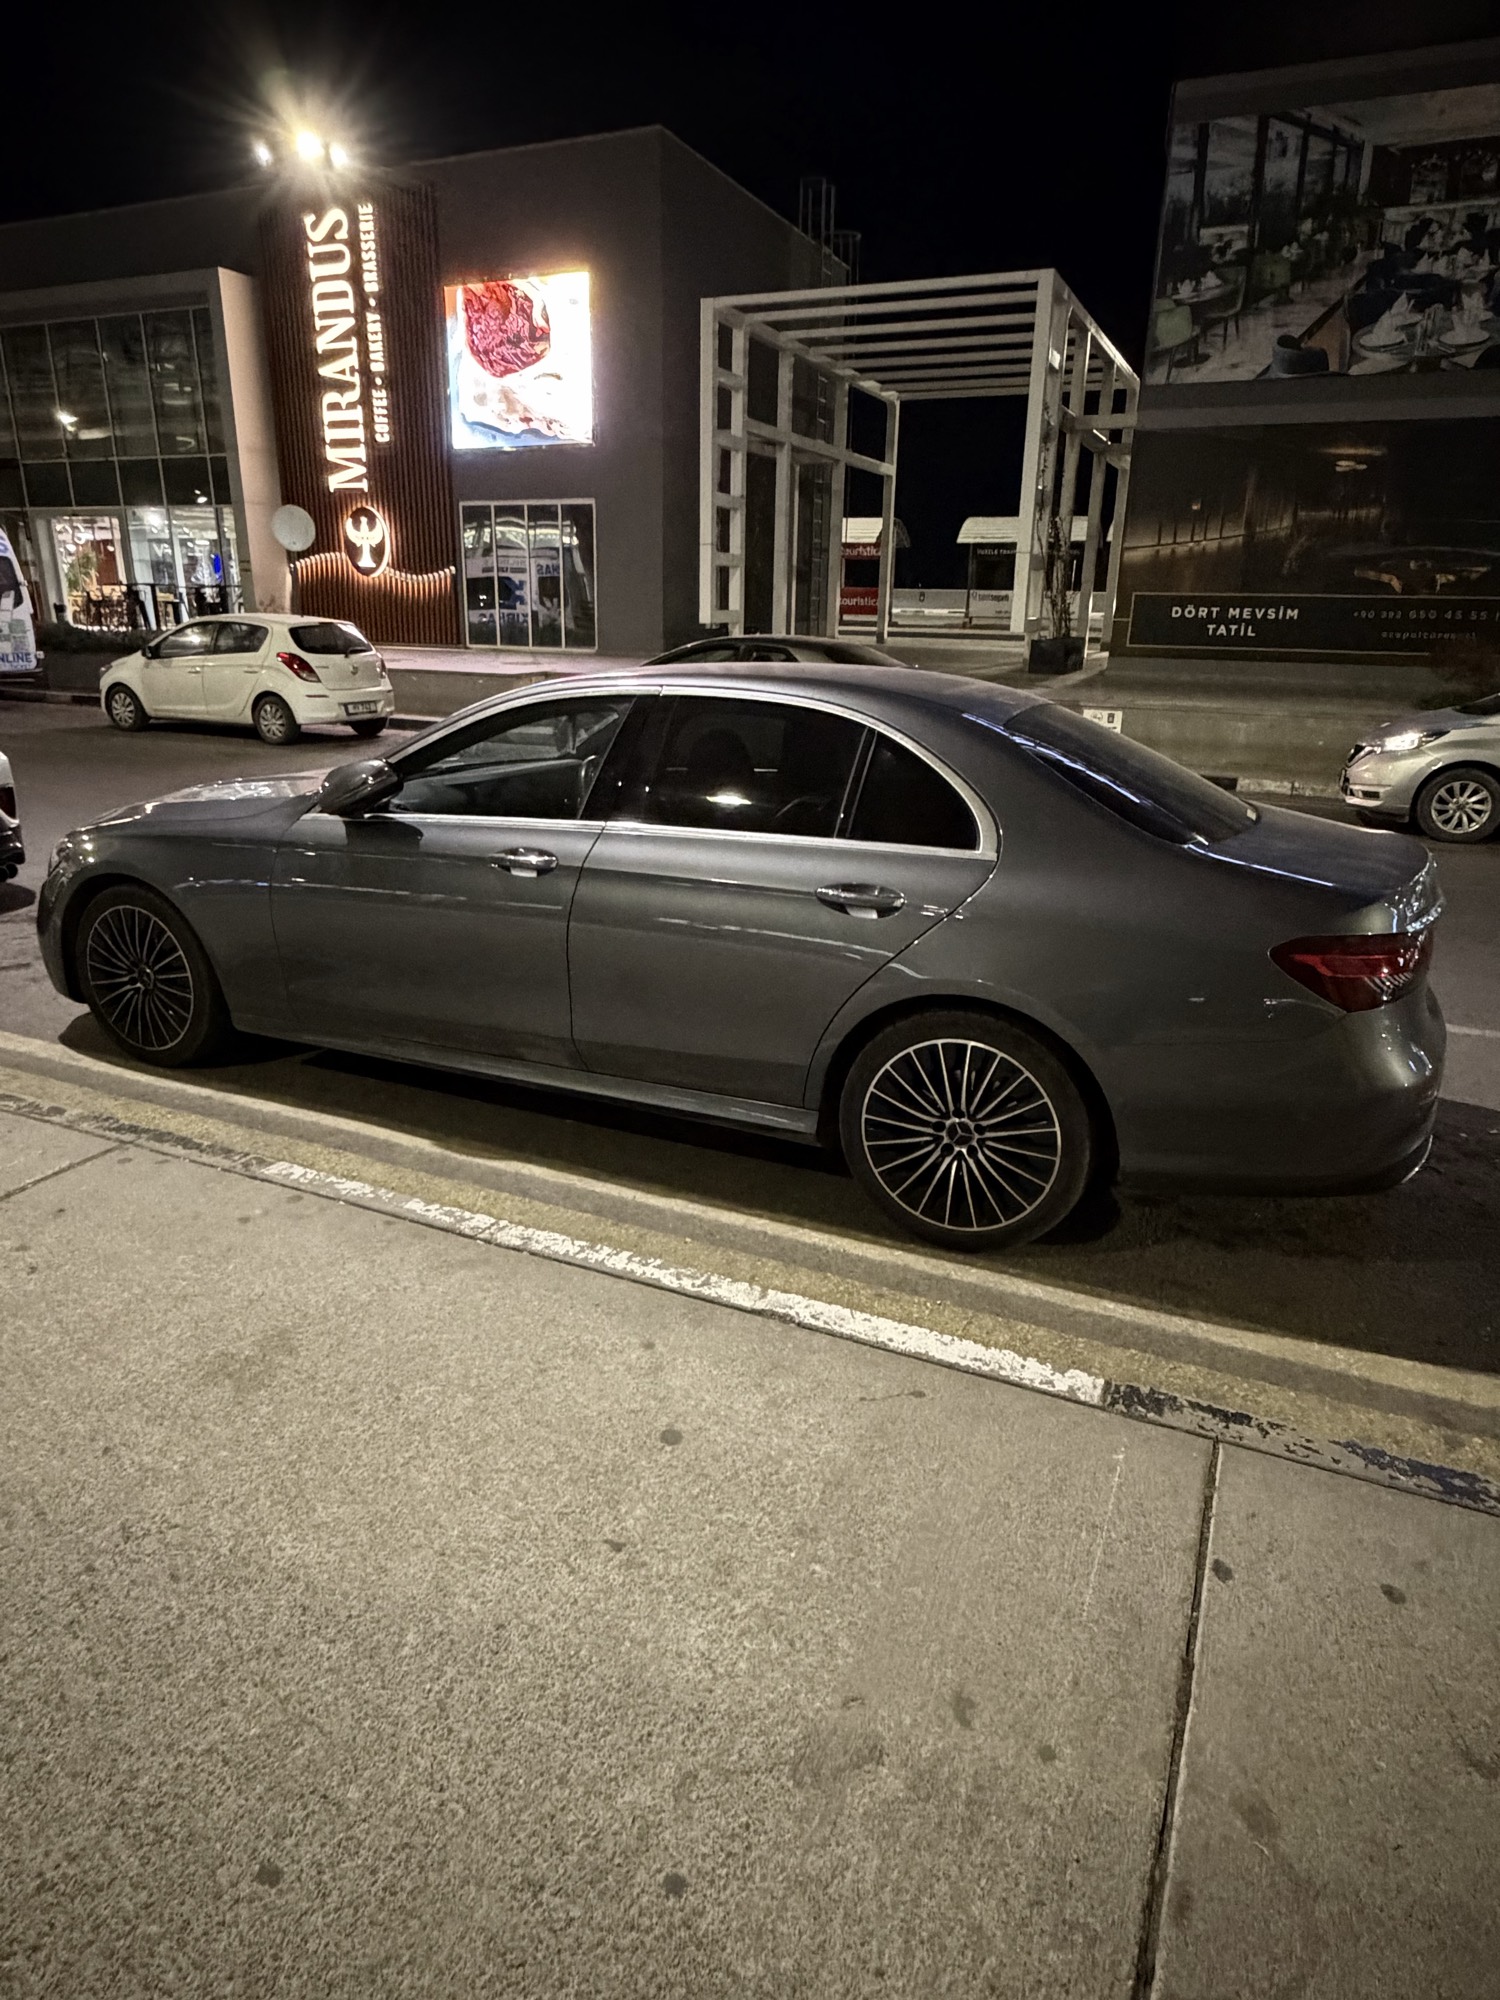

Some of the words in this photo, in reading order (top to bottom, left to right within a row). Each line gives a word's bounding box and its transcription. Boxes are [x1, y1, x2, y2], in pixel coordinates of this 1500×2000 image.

[357, 202, 379, 292] BRASSERIE
[303, 208, 369, 493] MIRANDUS
[365, 311, 384, 372] BAKERY
[371, 388, 390, 443] COFFEE
[1171, 605, 1220, 619] DÖRT
[1228, 606, 1299, 620] MEVSİM
[1207, 623, 1256, 637] TATİL
